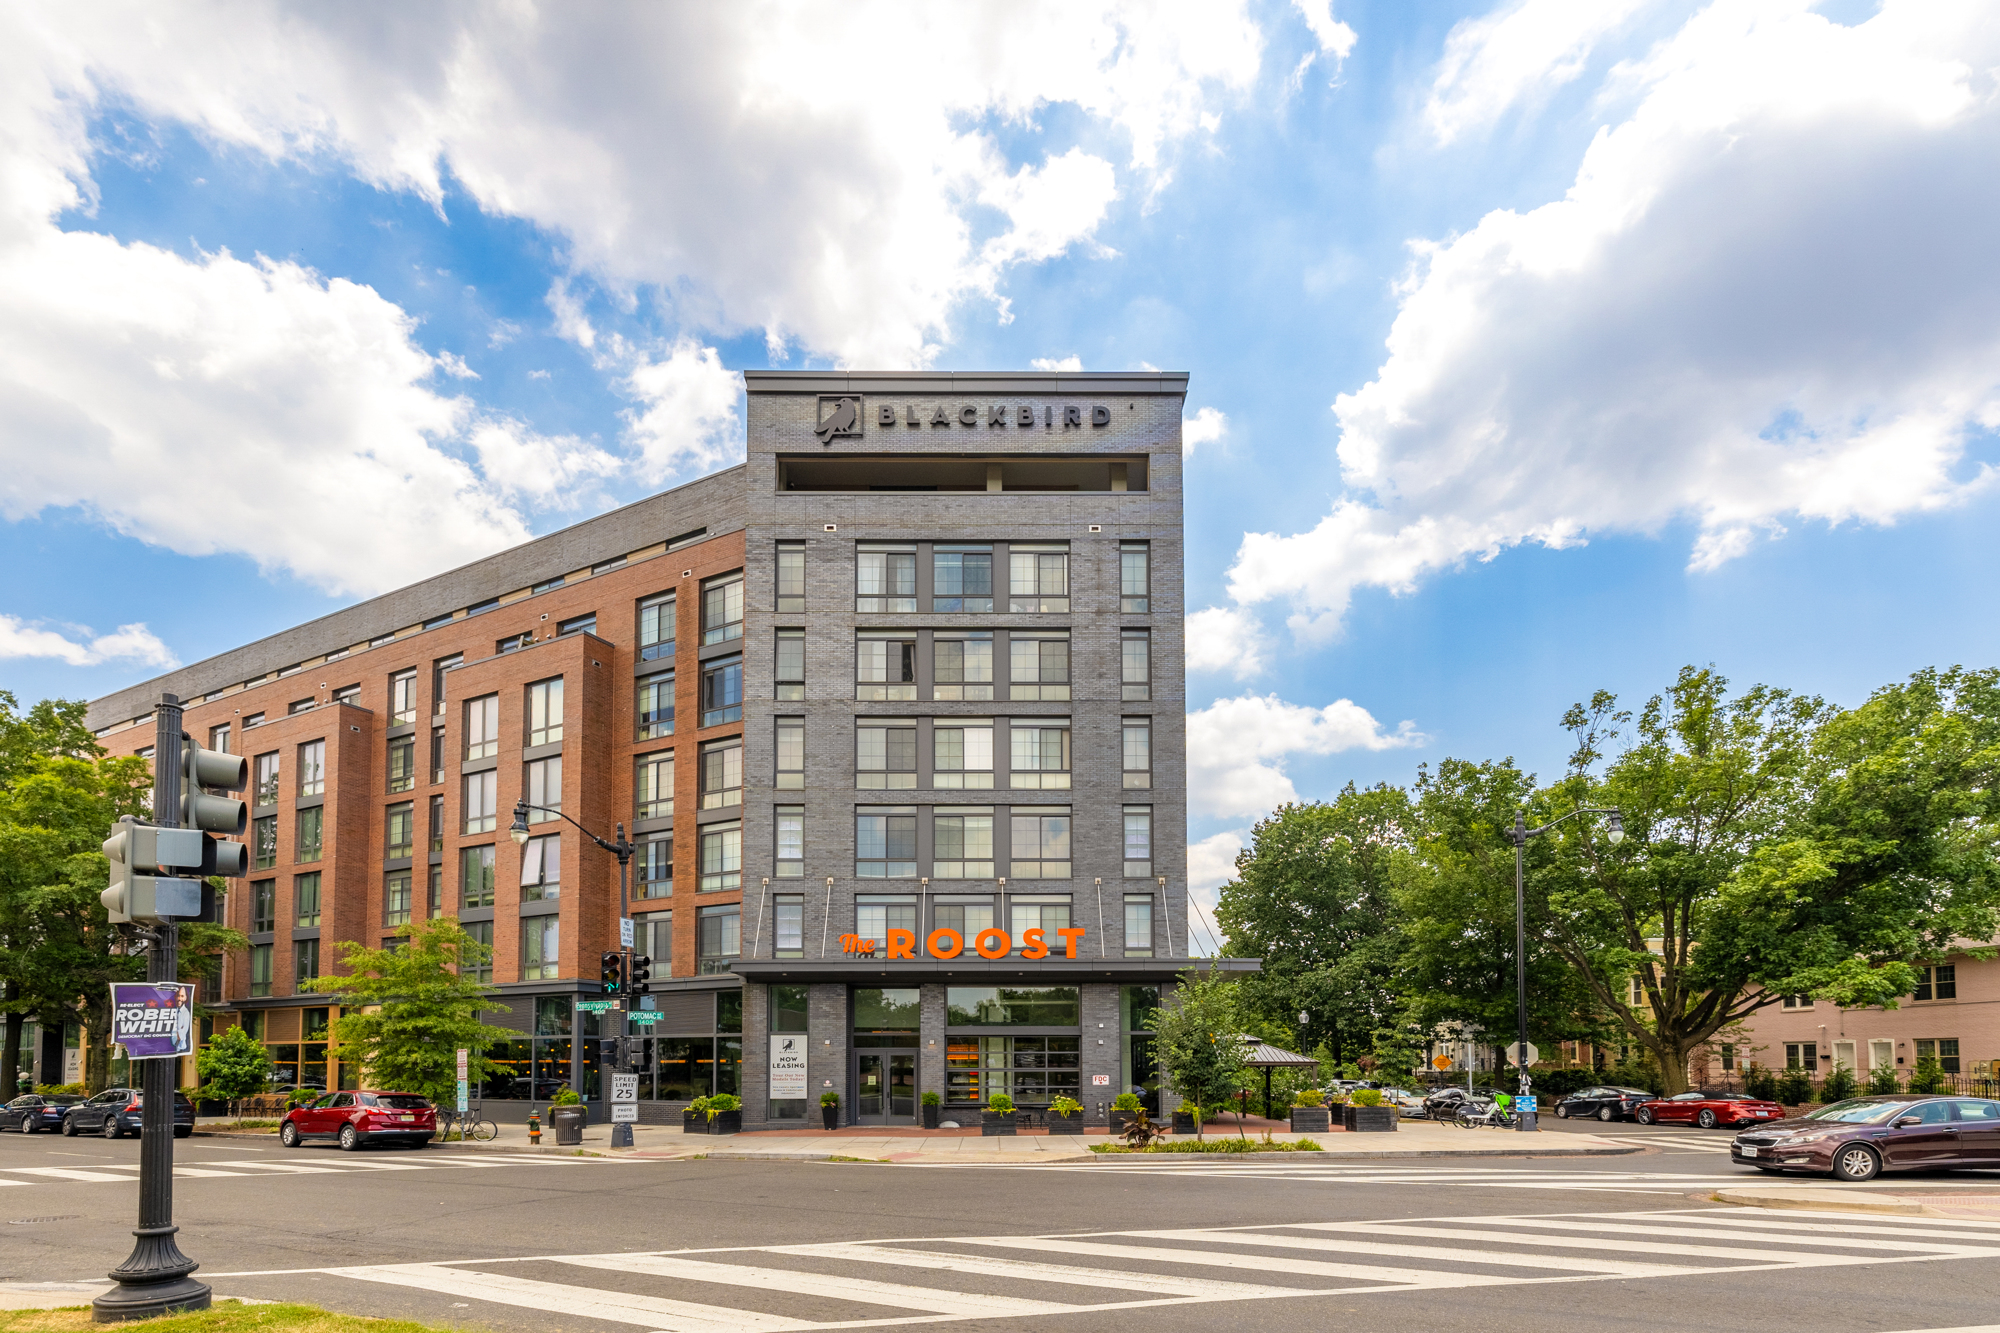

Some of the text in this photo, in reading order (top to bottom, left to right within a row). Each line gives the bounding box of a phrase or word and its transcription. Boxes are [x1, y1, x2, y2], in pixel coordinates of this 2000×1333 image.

[879, 405, 1111, 425] BLACKBIRD
[838, 928, 1085, 959] The ROOST
[116, 1008, 177, 1021] ROBER
[616, 1089, 633, 1098] 25
